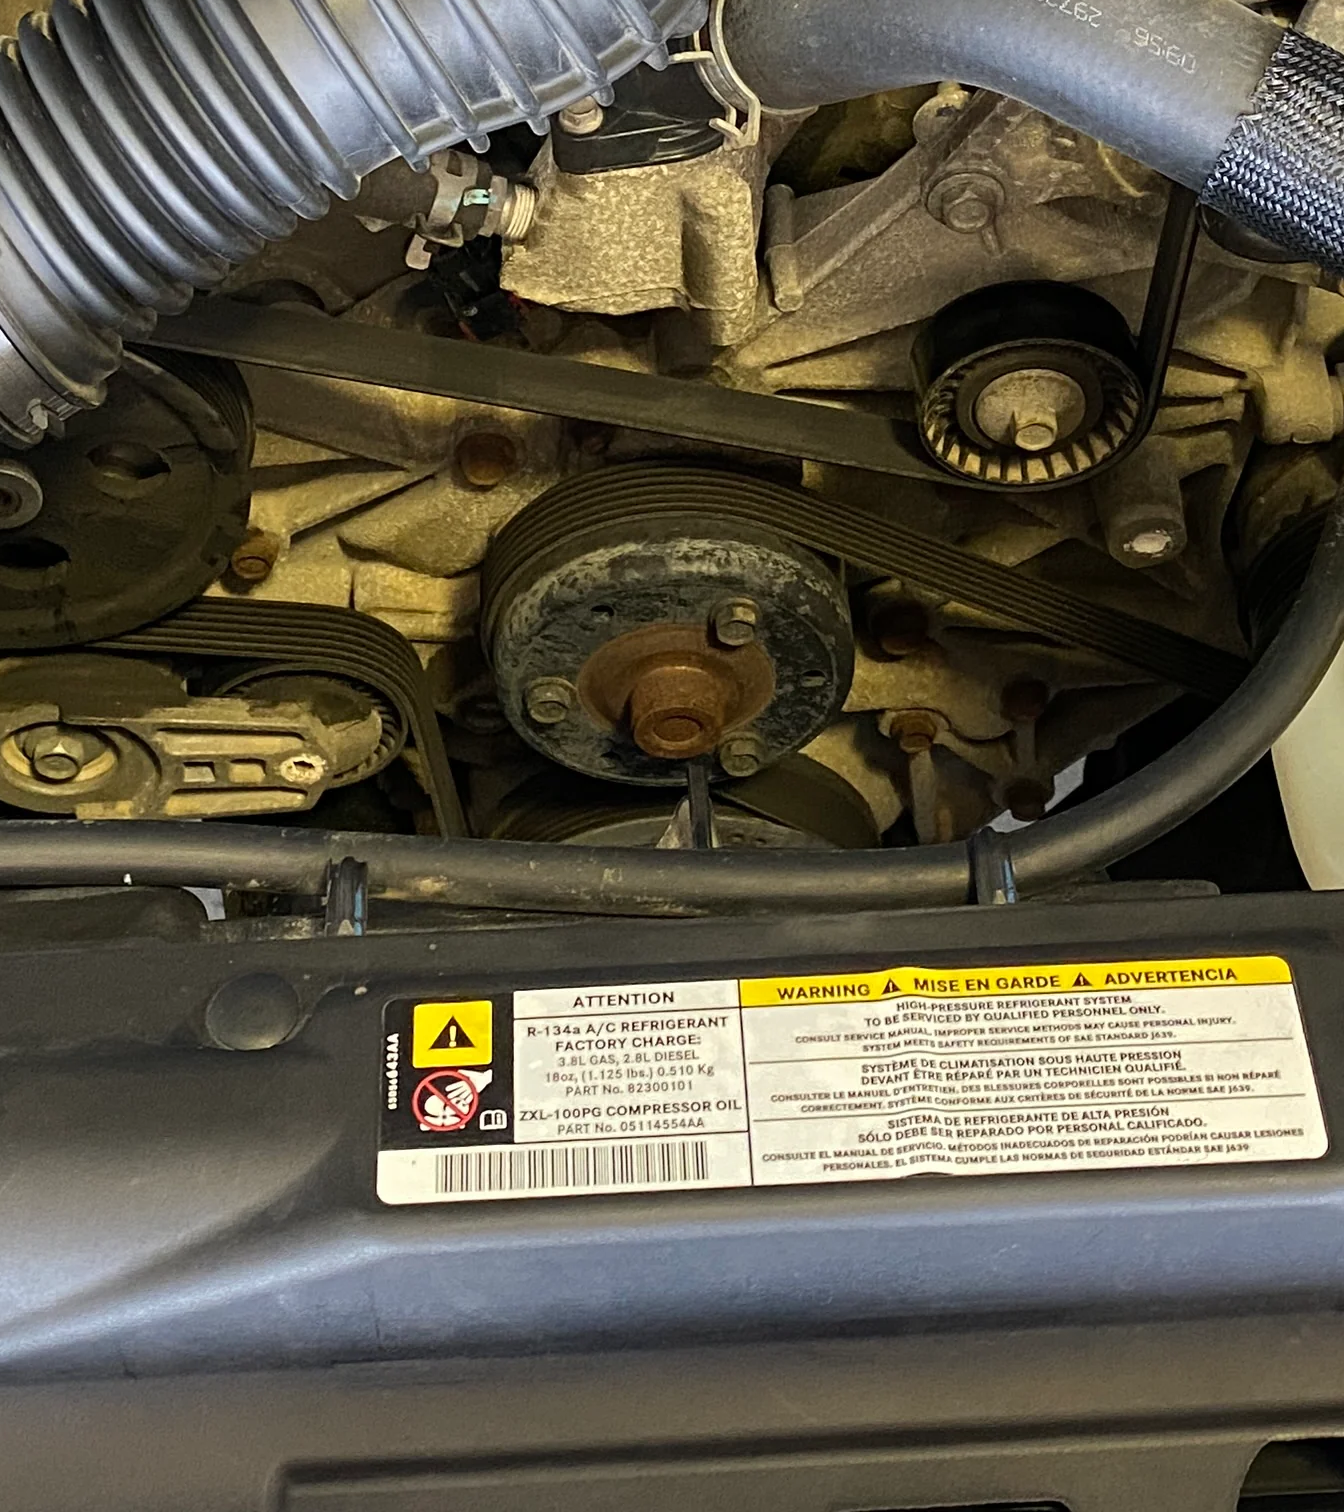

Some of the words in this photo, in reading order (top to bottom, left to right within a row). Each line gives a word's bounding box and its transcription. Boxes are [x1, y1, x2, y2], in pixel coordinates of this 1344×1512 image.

[914, 978, 959, 992] MISE
[966, 978, 990, 990] EN
[996, 975, 1060, 989] GARDE
[1105, 968, 1237, 985] ADVERTENCIA
[573, 991, 674, 1008] ATTENTION
[777, 984, 870, 1000] WARNING
[896, 1000, 994, 1012] HIGH-PRESSURE
[997, 997, 1080, 1010] REFRIGERANT
[1084, 995, 1132, 1006] SYSTEM
[864, 1018, 881, 1028] TO
[885, 1016, 900, 1026] BE
[903, 1013, 962, 1024] SERVICED
[965, 1013, 980, 1022] BY
[984, 1009, 1049, 1022] QUALIFIED
[1053, 1007, 1126, 1018] PERSONNEL
[1130, 1005, 1165, 1016] ONLY.
[527, 1024, 581, 1037] R-134a
[586, 1022, 616, 1035] A/C
[621, 1017, 728, 1032] REFRIGERANT
[796, 1034, 840, 1044] CONSULT
[844, 1032, 885, 1041] SERVICE
[935, 1027, 986, 1037] IMPROPER
[989, 1026, 1029, 1034] SERVICE
[1032, 1023, 1081, 1032] METHODS
[1084, 1022, 1105, 1030] MAY
[1108, 1020, 1140, 1029] CAUSE
[1144, 1018, 1195, 1028] PERSONAL
[556, 1038, 626, 1052] FACTORY
[632, 1035, 701, 1048] CHARGE:
[863, 1042, 901, 1052] SYSTEM
[904, 1039, 935, 1048] MEETS
[938, 1039, 975, 1048] SAFETY
[977, 1036, 1055, 1047] REQUIREMENTS
[1058, 1034, 1071, 1042] OF
[1074, 1033, 1094, 1042] SAE
[1096, 1031, 1148, 1040] STANDARD
[558, 1056, 585, 1067] 3.8L
[589, 1054, 616, 1066] GAS,
[623, 1052, 650, 1063] 2.8L
[655, 1050, 699, 1061] DIESEL
[862, 1058, 917, 1074] SYSTÈME
[921, 1058, 937, 1069] DE
[939, 1057, 1035, 1070] CLIMATISATION
[1038, 1054, 1073, 1066] SOUS
[1076, 1053, 1116, 1064] HAUTE
[1120, 1050, 1182, 1062] PRESSION
[546, 1072, 578, 1083] 18oz,
[581, 1069, 622, 1083] (1.125
[627, 1067, 653, 1081] lbs.)
[657, 1066, 693, 1077] 0.510
[698, 1064, 714, 1076] Kg
[861, 1073, 909, 1086] DEVANT
[913, 1068, 943, 1081] ÊTRE
[946, 1068, 994, 1081] RÉPARÉ
[996, 1068, 1021, 1079] PAR
[1024, 1068, 1042, 1078] UN
[1046, 1064, 1122, 1077] TECHNICIEN
[566, 1085, 599, 1096] PART
[603, 1084, 623, 1095] No.
[628, 1081, 693, 1093] 82300101
[520, 1107, 602, 1121] ZXL-100PG
[607, 1102, 711, 1117] COMPRESSOR
[717, 1100, 742, 1112] OIL
[888, 1114, 942, 1130] SISTEMA
[945, 1116, 961, 1126] DE
[964, 1112, 1059, 1126] REFRIGERANTE
[1062, 1111, 1078, 1121] DE
[1082, 1109, 1112, 1120] ALTA
[1115, 1106, 1169, 1118] PRESIÓN
[558, 1123, 594, 1135] PART
[597, 1121, 616, 1133] No.
[621, 1118, 704, 1132] 05114554AA
[858, 1130, 892, 1144] SÓLO
[895, 1126, 927, 1139] DEBE
[931, 1126, 953, 1138] SER
[956, 1126, 1024, 1138] REPARADO
[1027, 1124, 1054, 1136] POR
[1057, 1120, 1125, 1133] PERSONAL
